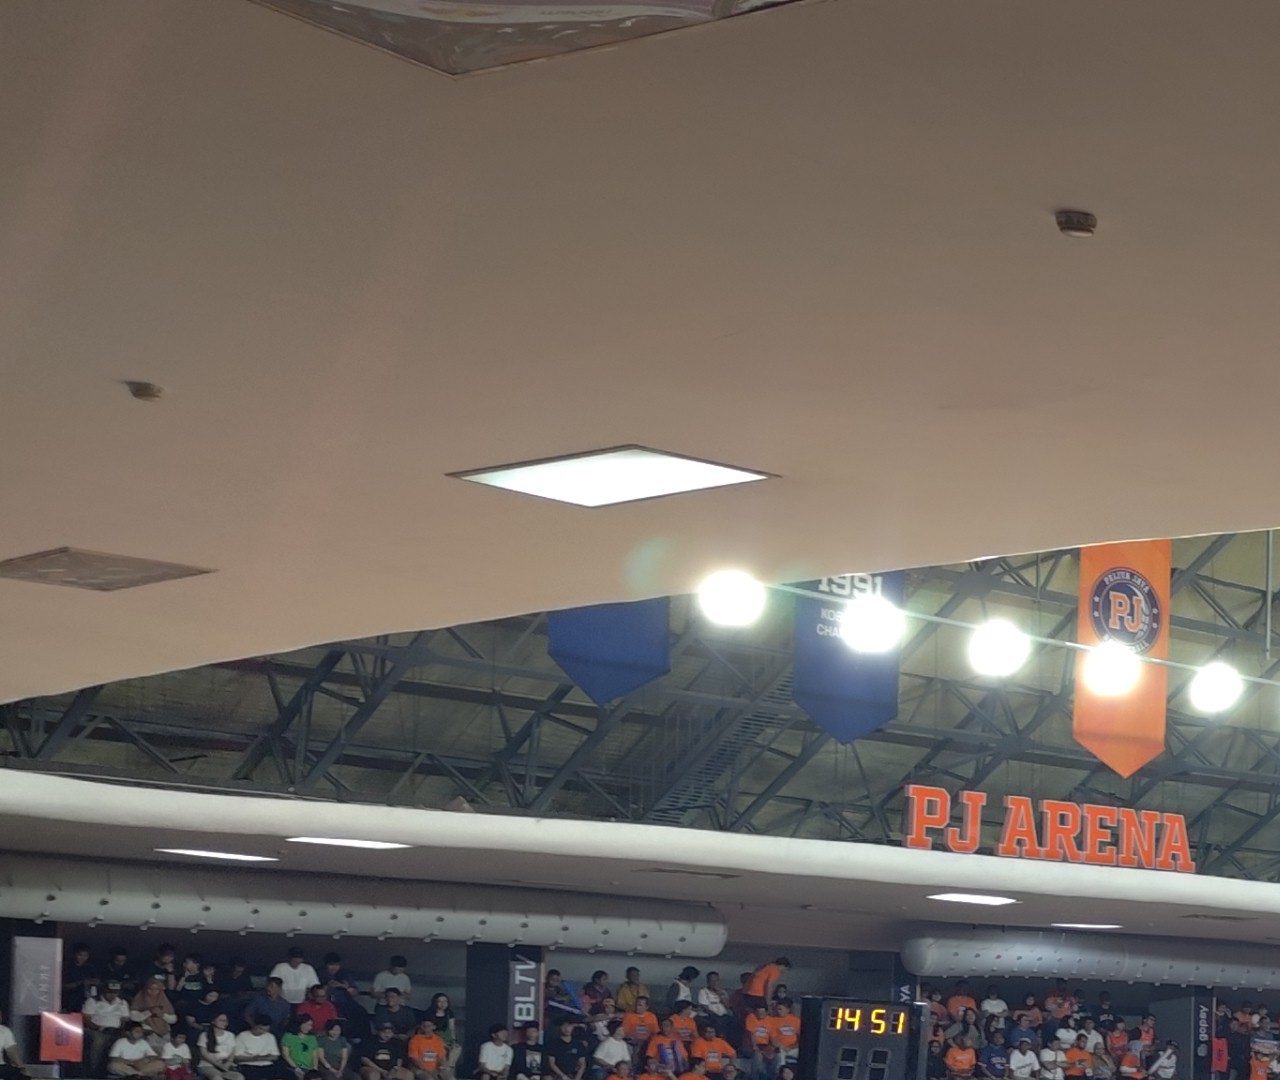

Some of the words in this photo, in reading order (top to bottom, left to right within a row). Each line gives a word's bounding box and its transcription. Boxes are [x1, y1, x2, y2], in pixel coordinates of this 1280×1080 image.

[1108, 590, 1142, 633] PJ
[905, 784, 985, 855] PJ
[1001, 795, 1195, 873] ARENA
